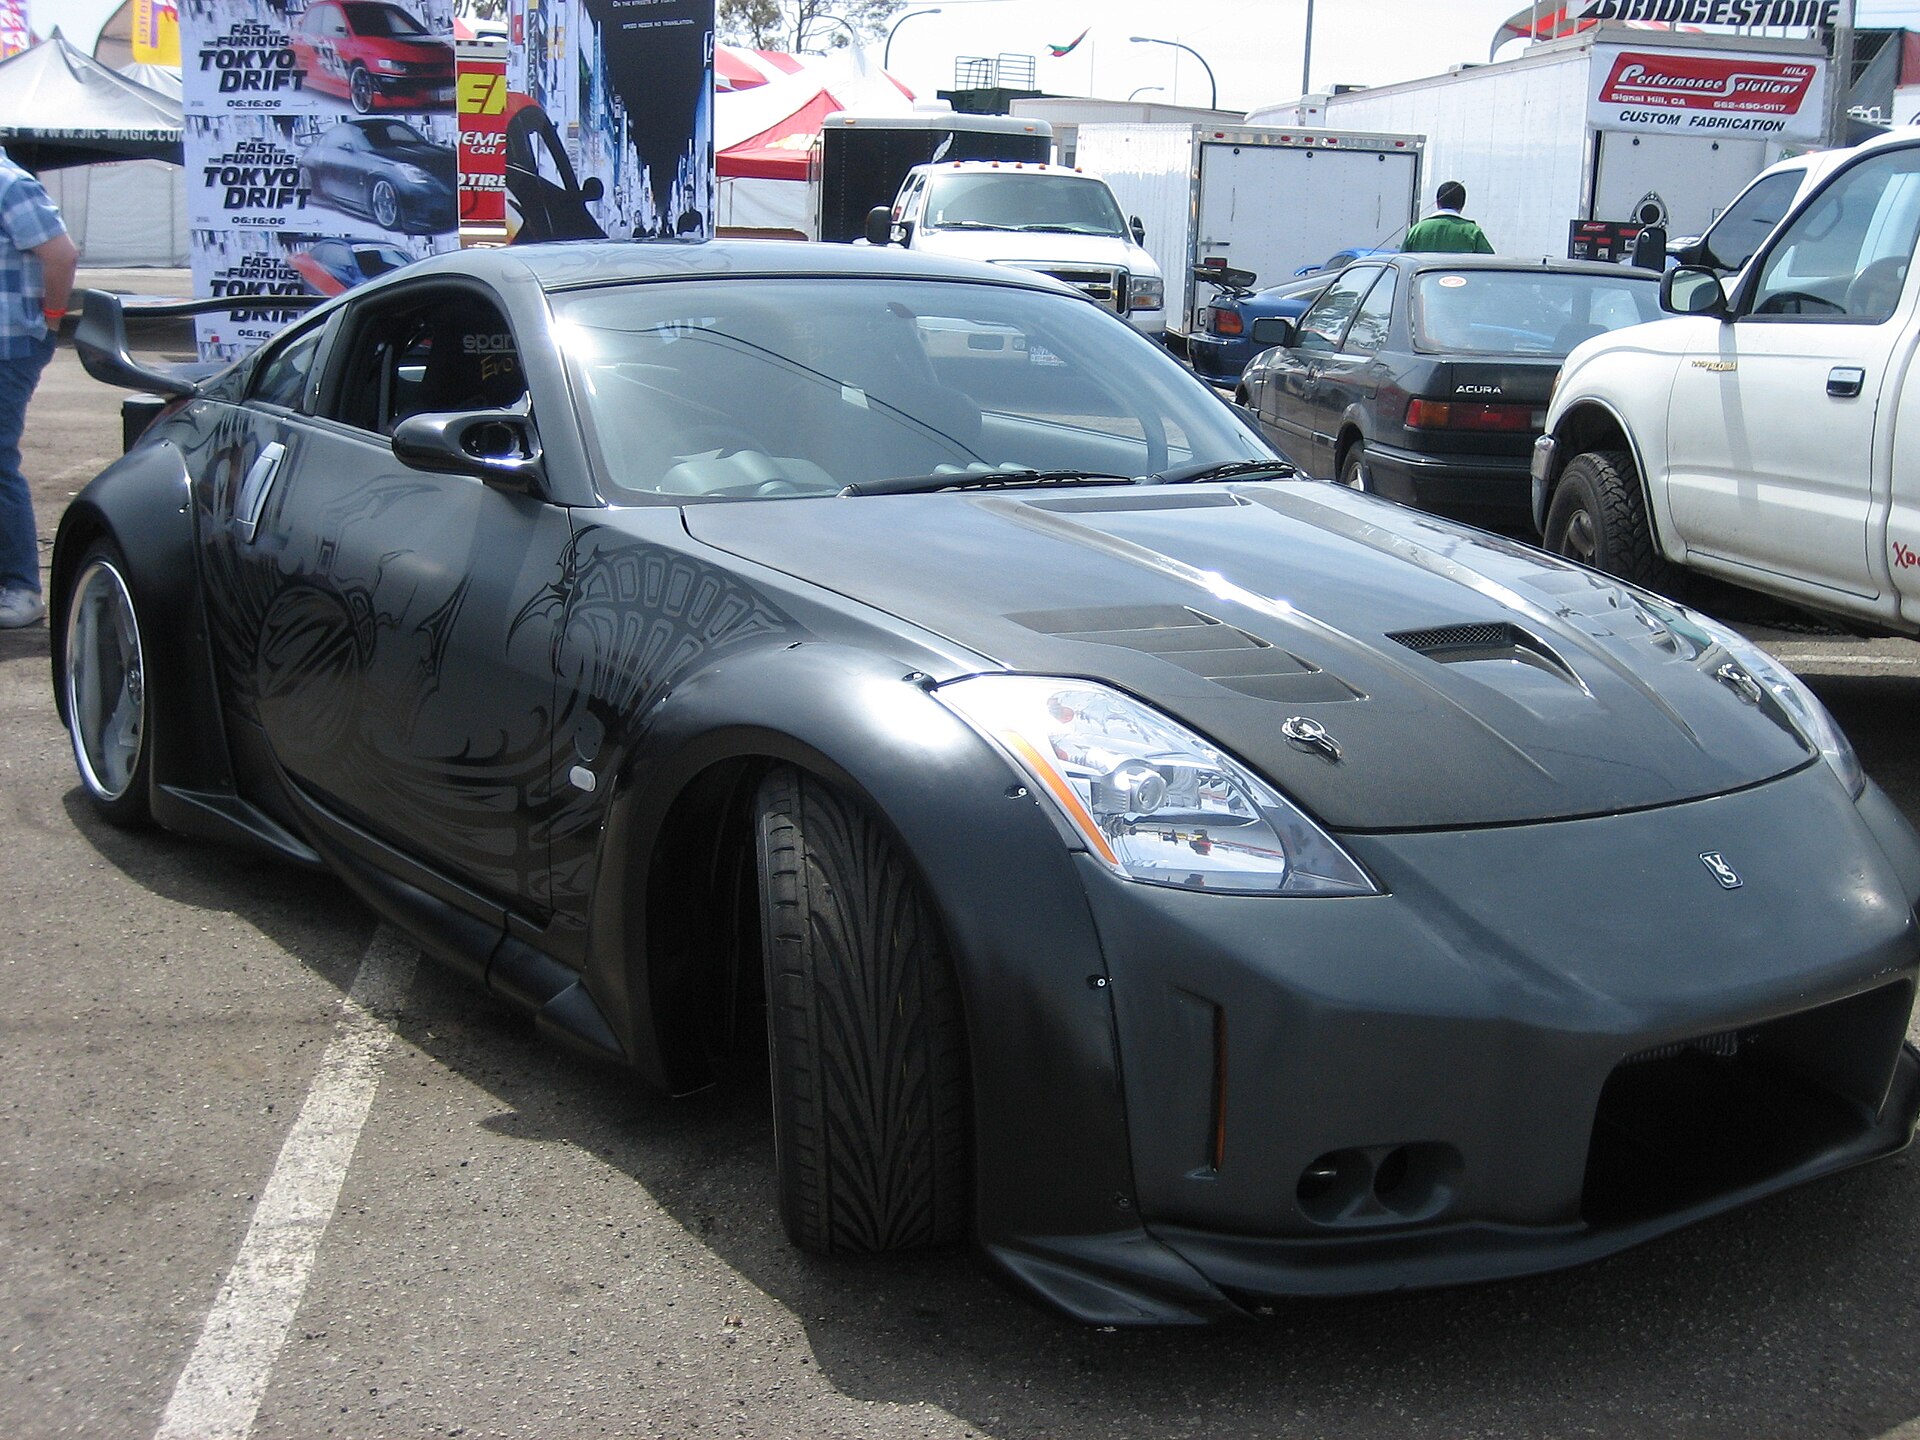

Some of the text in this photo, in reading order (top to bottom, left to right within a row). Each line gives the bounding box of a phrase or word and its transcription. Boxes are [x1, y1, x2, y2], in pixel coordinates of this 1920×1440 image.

[1580, 0, 1840, 27] BRIDGESTONE
[230, 24, 270, 35] FAST
[216, 36, 294, 47] FURIOUS:
[199, 49, 296, 71] TOKYO
[1782, 66, 1809, 76] HILL
[219, 70, 308, 93] DRIFT
[1618, 64, 1799, 97] Performance Solutions
[1611, 93, 1644, 103] Signal
[1647, 95, 1667, 104] Hill,
[1671, 97, 1686, 105] CA
[1620, 110, 1786, 132] CUSTOM FABRICATION
[236, 142, 276, 153] FAST
[470, 146, 495, 154] CAR
[221, 154, 298, 165] FURIOUS:
[203, 166, 300, 187] TOKYO
[223, 187, 311, 210] DRIFT
[241, 256, 281, 268] FAST
[210, 280, 304, 297] TOKYO
[229, 308, 300, 323] DRIF
[463, 334, 513, 354] spar
[1456, 385, 1502, 394] ACURA
